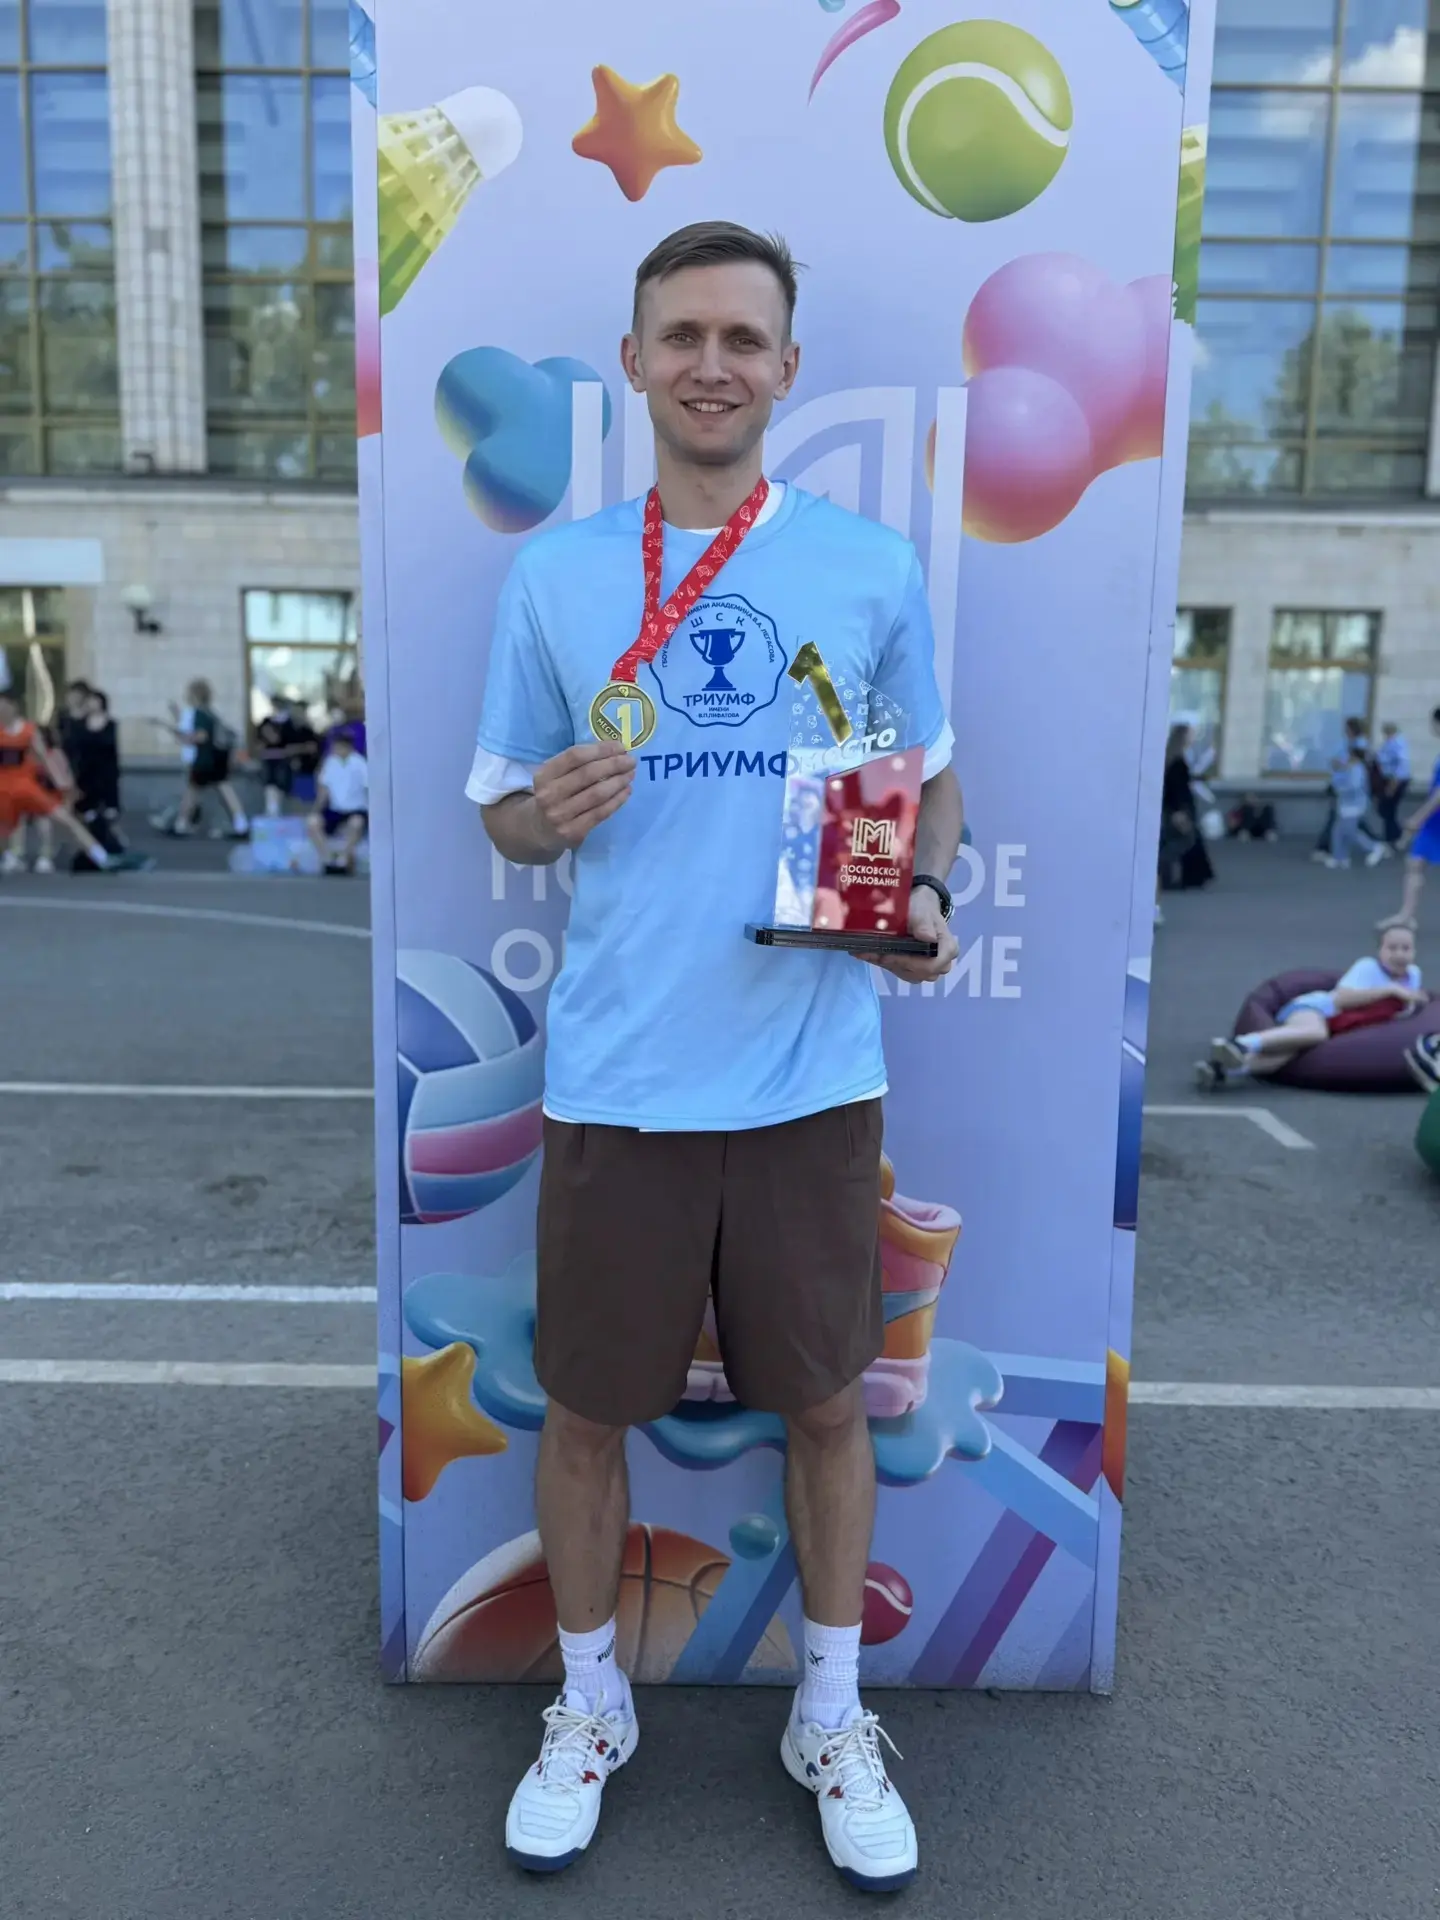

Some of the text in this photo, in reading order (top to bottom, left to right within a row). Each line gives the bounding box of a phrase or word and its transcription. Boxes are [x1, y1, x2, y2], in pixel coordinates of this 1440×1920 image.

[683, 692, 755, 707] ТРИУМФ
[597, 718, 618, 739] МЕСТО
[840, 864, 901, 877] МОСКОВСКОЕ
[840, 874, 900, 887] ОБРАЗОВАНИЕ
